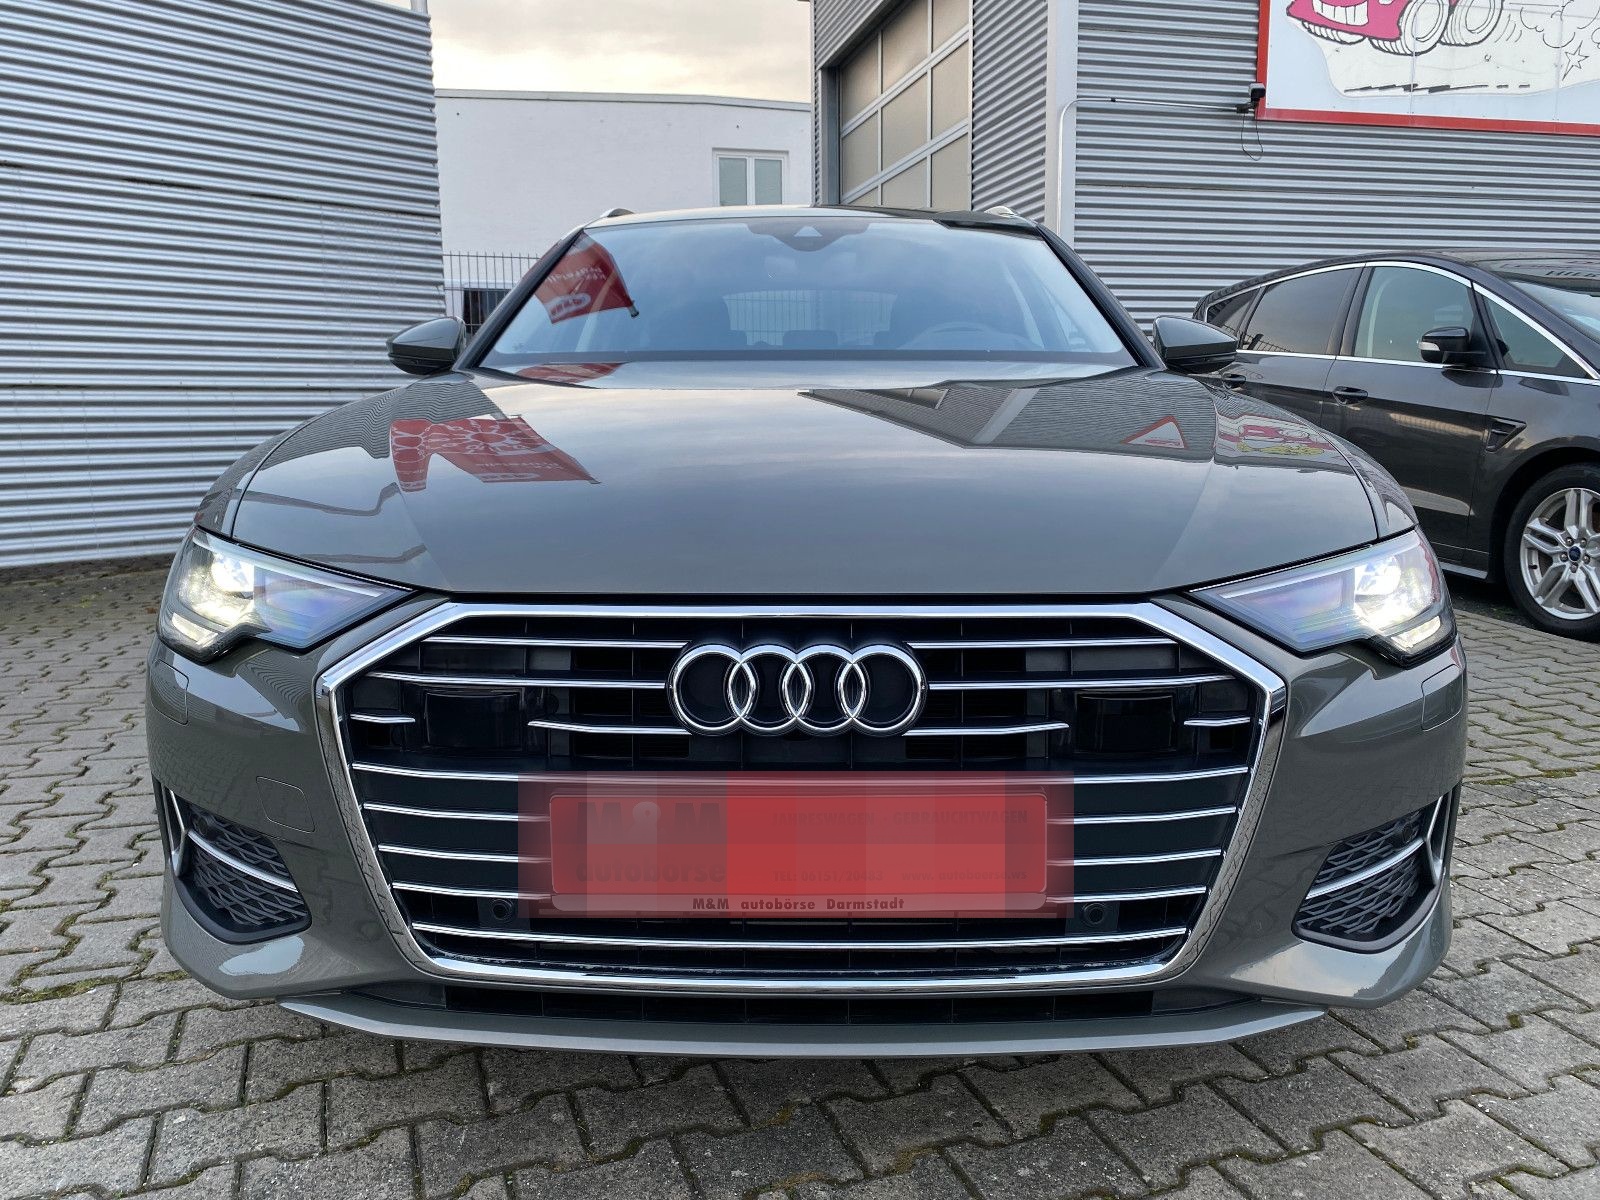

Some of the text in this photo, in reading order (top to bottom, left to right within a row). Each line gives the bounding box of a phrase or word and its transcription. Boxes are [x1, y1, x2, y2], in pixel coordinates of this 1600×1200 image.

[692, 897, 904, 910] M&M autobörse Darmstadt
